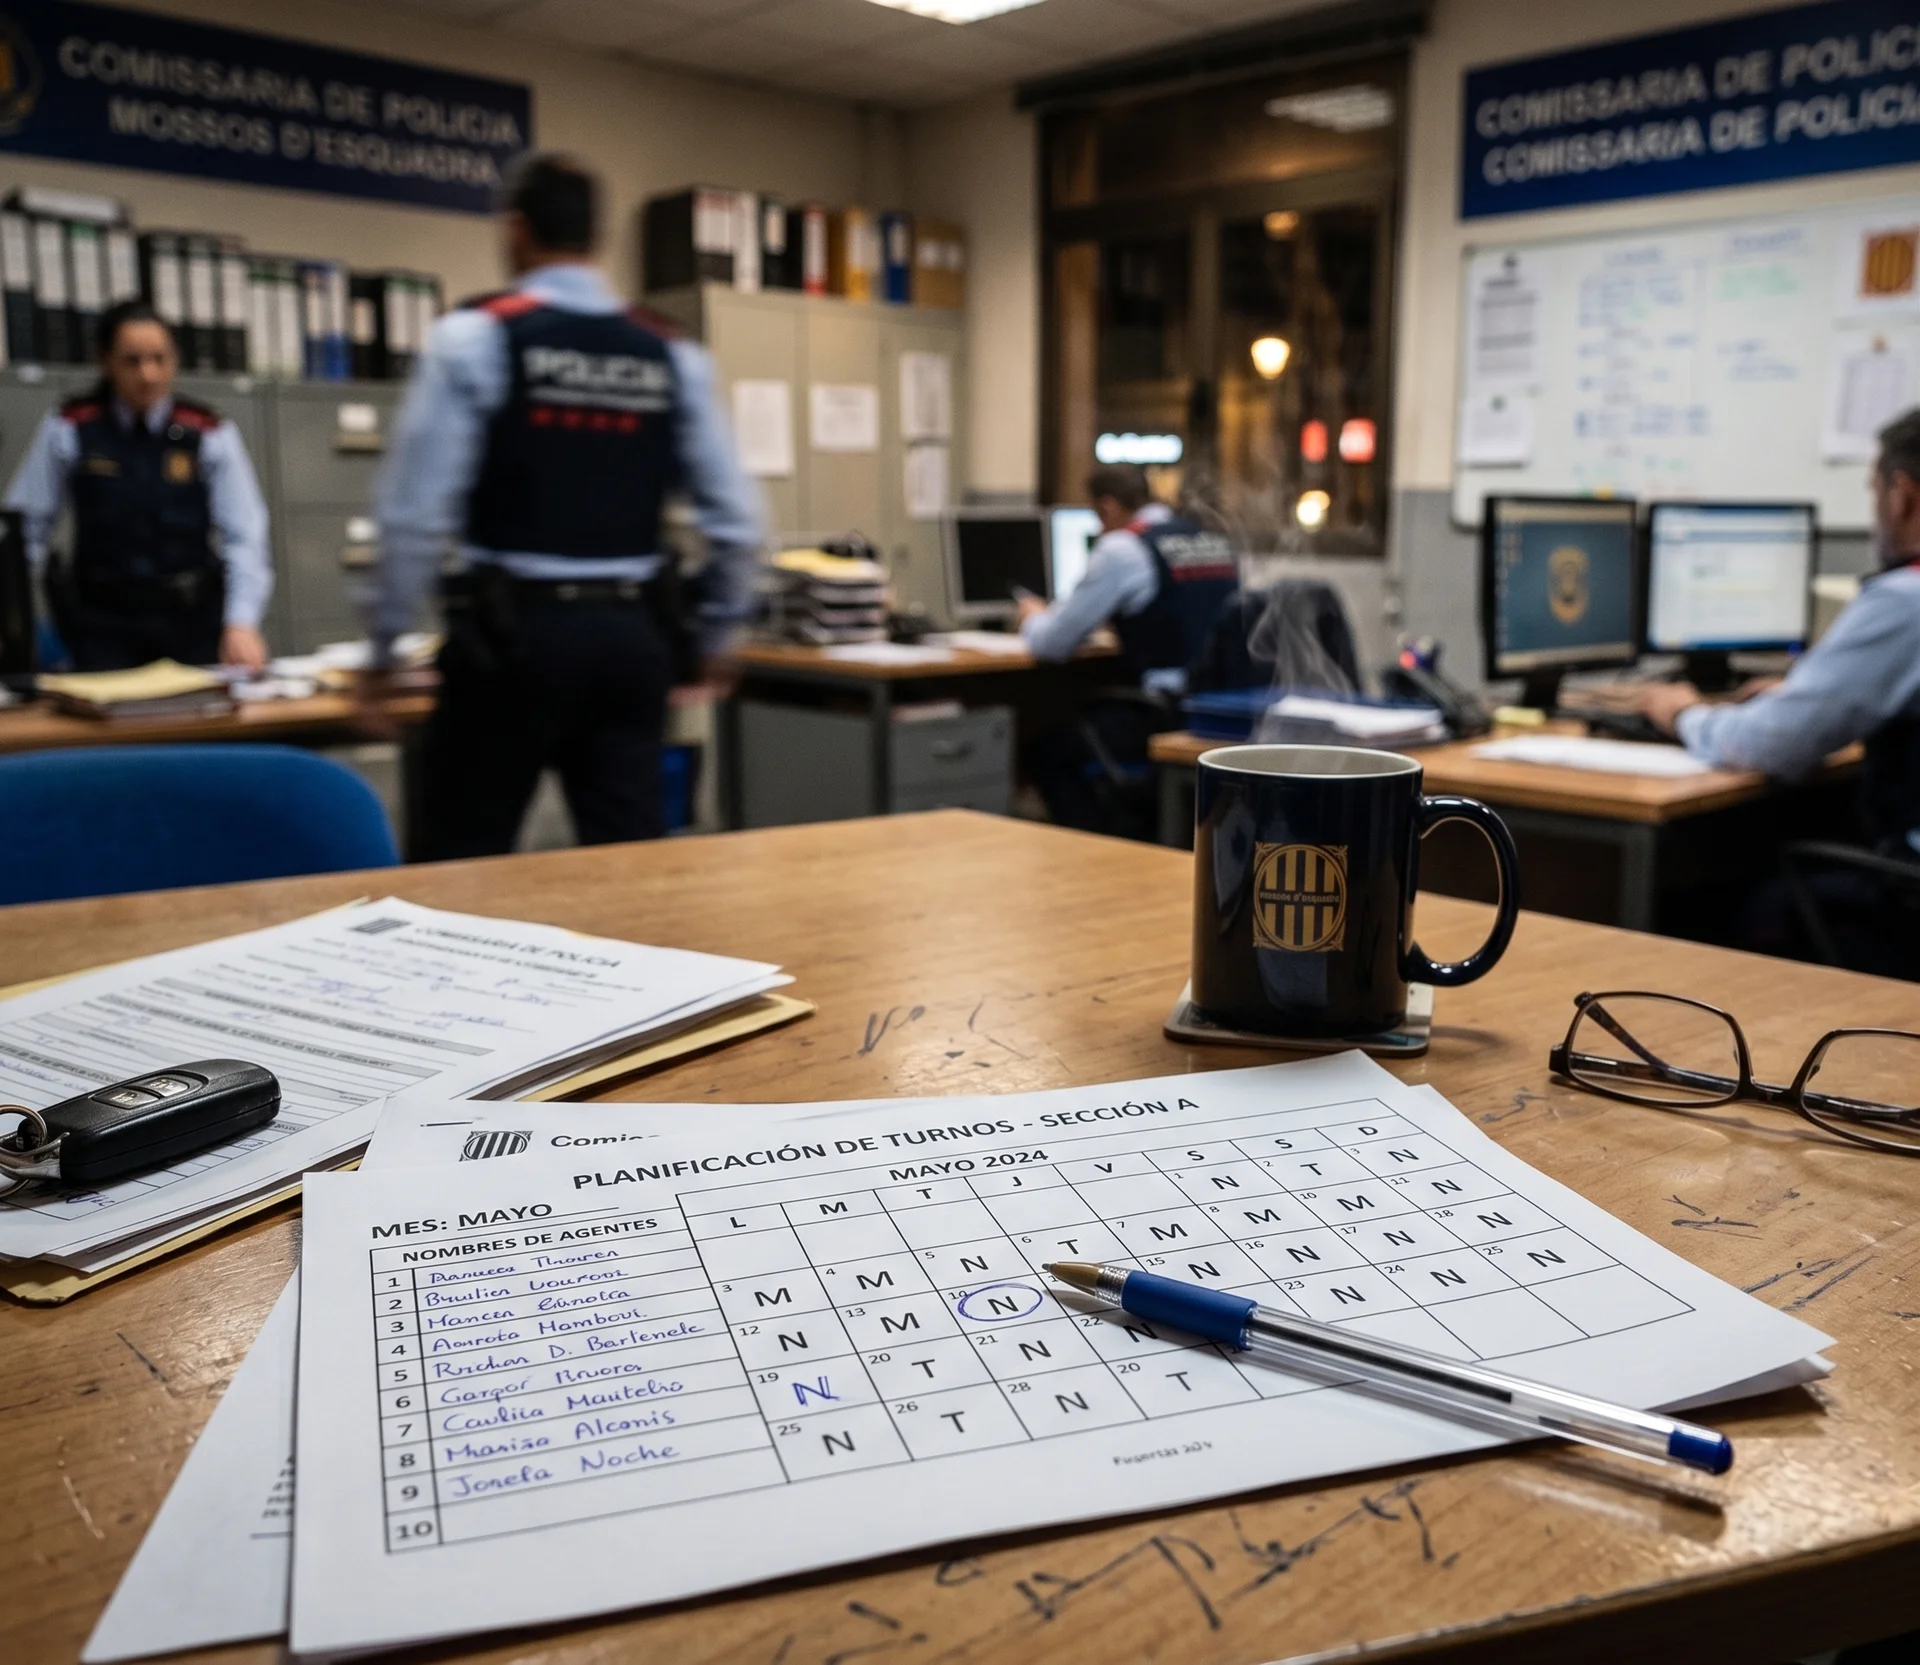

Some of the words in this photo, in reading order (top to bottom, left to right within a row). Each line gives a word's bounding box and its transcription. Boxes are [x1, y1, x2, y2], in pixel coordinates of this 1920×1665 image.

[1714, 49, 1771, 98] DE
[1781, 24, 1920, 88] POLIC
[323, 81, 373, 126] DE
[109, 96, 274, 155] MOSSOS
[1709, 105, 1769, 153] DE
[573, 1144, 827, 1189] PLANIFICACIÓN
[835, 1137, 878, 1155] DE
[882, 1120, 1015, 1149] TURNOS
[1039, 1100, 1168, 1128] SECCIÓN
[1177, 1098, 1200, 1111] A
[888, 1159, 976, 1182] MAYO
[982, 1150, 1049, 1169] 2024
[1388, 1149, 1419, 1162] N
[730, 1216, 746, 1228] L
[819, 1202, 848, 1215] M
[916, 1188, 933, 1200] T
[1011, 1176, 1023, 1188] J
[1094, 1162, 1113, 1175] V
[1187, 1150, 1205, 1161] S
[1274, 1139, 1293, 1150] S
[1357, 1126, 1378, 1136] D
[1263, 1160, 1274, 1168] 2
[1300, 1163, 1323, 1176] T
[1210, 1176, 1240, 1190] N
[1390, 1176, 1410, 1186] 11
[1431, 1179, 1463, 1194] N
[1299, 1192, 1317, 1200] 10
[1336, 1195, 1375, 1211] M
[372, 1219, 448, 1239] MES:
[457, 1203, 552, 1227] MAYO
[1209, 1206, 1220, 1214] 8
[1243, 1208, 1282, 1225] M
[1434, 1209, 1454, 1219] 18
[1477, 1211, 1513, 1228] N
[402, 1238, 517, 1263] NOMBRES
[524, 1233, 553, 1246] DE
[559, 1218, 658, 1242] AGENTES
[1116, 1221, 1125, 1229] 7
[1149, 1223, 1189, 1241] M
[1341, 1226, 1358, 1235] 17
[1382, 1230, 1416, 1246] N
[1021, 1236, 1032, 1244] 6
[1057, 1239, 1079, 1255] T
[1244, 1240, 1264, 1250] 16
[1286, 1245, 1321, 1263] N
[1483, 1246, 1504, 1256] 25
[1527, 1249, 1567, 1267] N
[924, 1251, 935, 1260] 5
[959, 1255, 989, 1273] N
[1145, 1256, 1165, 1267] 15
[1187, 1261, 1221, 1279] N
[388, 1277, 401, 1288] 1
[825, 1268, 836, 1276] 4
[855, 1270, 895, 1290] M
[1384, 1264, 1405, 1274] 24
[1429, 1269, 1467, 1287] N
[722, 1284, 733, 1293] 3
[754, 1287, 792, 1307] M
[1284, 1280, 1305, 1291] 23
[1329, 1285, 1366, 1304] N
[389, 1299, 403, 1310] 2
[987, 1296, 1019, 1315] N
[390, 1321, 404, 1333] 3
[845, 1307, 866, 1318] 13
[880, 1312, 921, 1333] M
[1080, 1316, 1103, 1327] 22
[1122, 1322, 1159, 1343] N
[739, 1325, 761, 1336] 12
[777, 1331, 809, 1351] N
[976, 1334, 999, 1345] 21
[1018, 1340, 1052, 1361] N
[391, 1345, 407, 1355] 4
[394, 1370, 408, 1382] 5
[868, 1353, 891, 1365] 20
[911, 1359, 936, 1378] T
[1117, 1362, 1141, 1374] 20
[1165, 1371, 1192, 1391] T
[757, 1372, 779, 1384] 19
[791, 1375, 840, 1406] N
[1008, 1381, 1032, 1394] 28
[1054, 1391, 1089, 1413] N
[395, 1396, 411, 1408] 6
[895, 1401, 918, 1414] 26
[940, 1411, 965, 1433] T
[397, 1424, 412, 1437] 7
[777, 1424, 801, 1436] 25
[821, 1430, 856, 1455] N
[399, 1453, 415, 1468] 8
[580, 1445, 680, 1473] Noche
[401, 1485, 419, 1500] 9
[396, 1520, 433, 1540] 10
